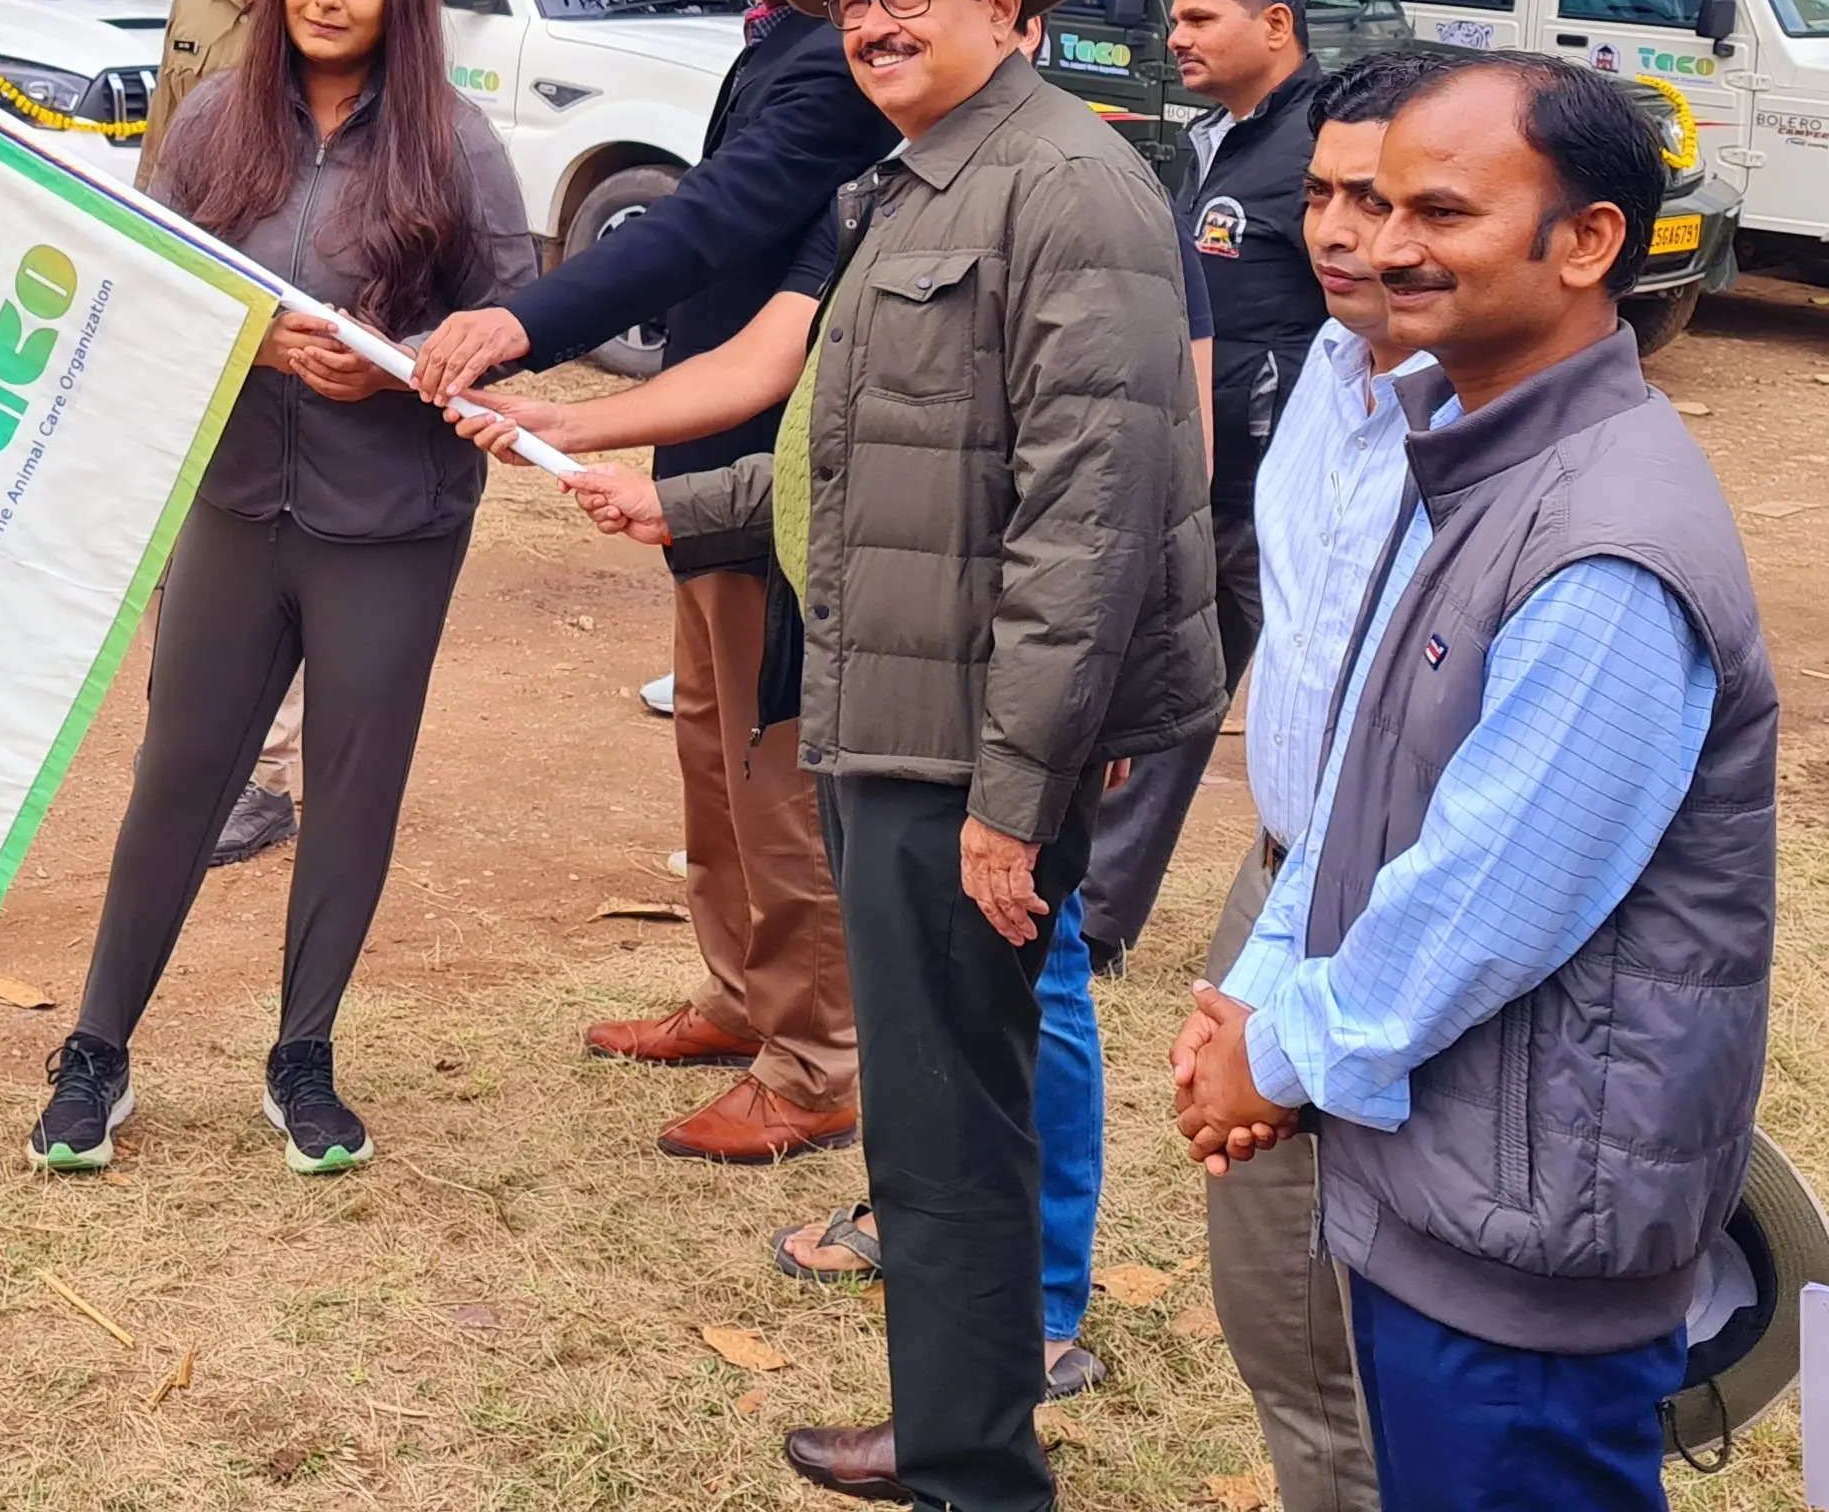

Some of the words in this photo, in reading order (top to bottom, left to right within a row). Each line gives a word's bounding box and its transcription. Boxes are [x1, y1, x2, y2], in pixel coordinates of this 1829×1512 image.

[1756, 112, 1822, 131] BOLERO
[6, 439, 46, 505] Animal
[38, 393, 67, 438] Care
[59, 278, 114, 391] Organization
